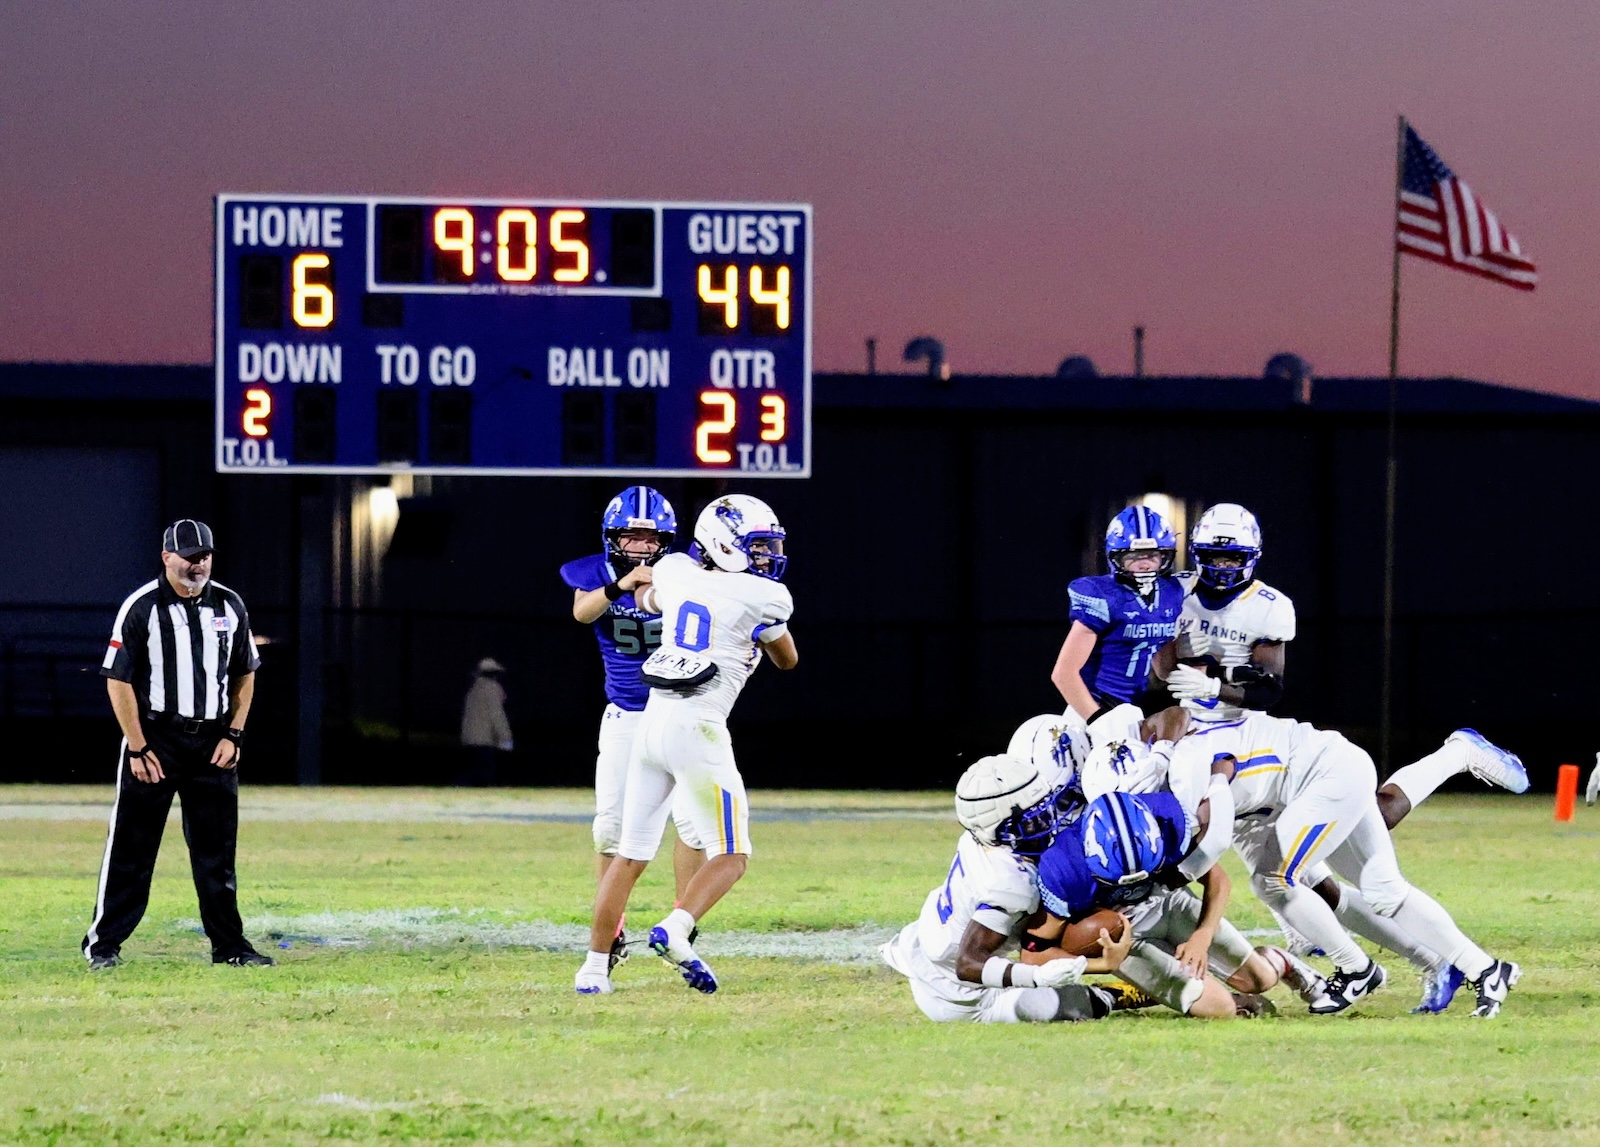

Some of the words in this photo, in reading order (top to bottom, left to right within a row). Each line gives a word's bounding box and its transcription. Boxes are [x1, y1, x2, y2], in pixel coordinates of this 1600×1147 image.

[232, 206, 344, 248] HOME
[688, 214, 800, 255] GUEST
[292, 253, 333, 327] 6
[697, 264, 790, 329] 44
[237, 342, 343, 384] DOWN
[375, 344, 420, 386] TO
[428, 345, 477, 387] GO
[547, 346, 622, 387] BALL
[627, 347, 670, 388] ON
[709, 349, 776, 389] QTR
[243, 388, 272, 437] 2
[696, 391, 736, 463] 2
[760, 394, 785, 441] 3
[222, 437, 289, 467] T.O.L.
[674, 599, 712, 653] 0
[1200, 619, 1248, 643] RANCH
